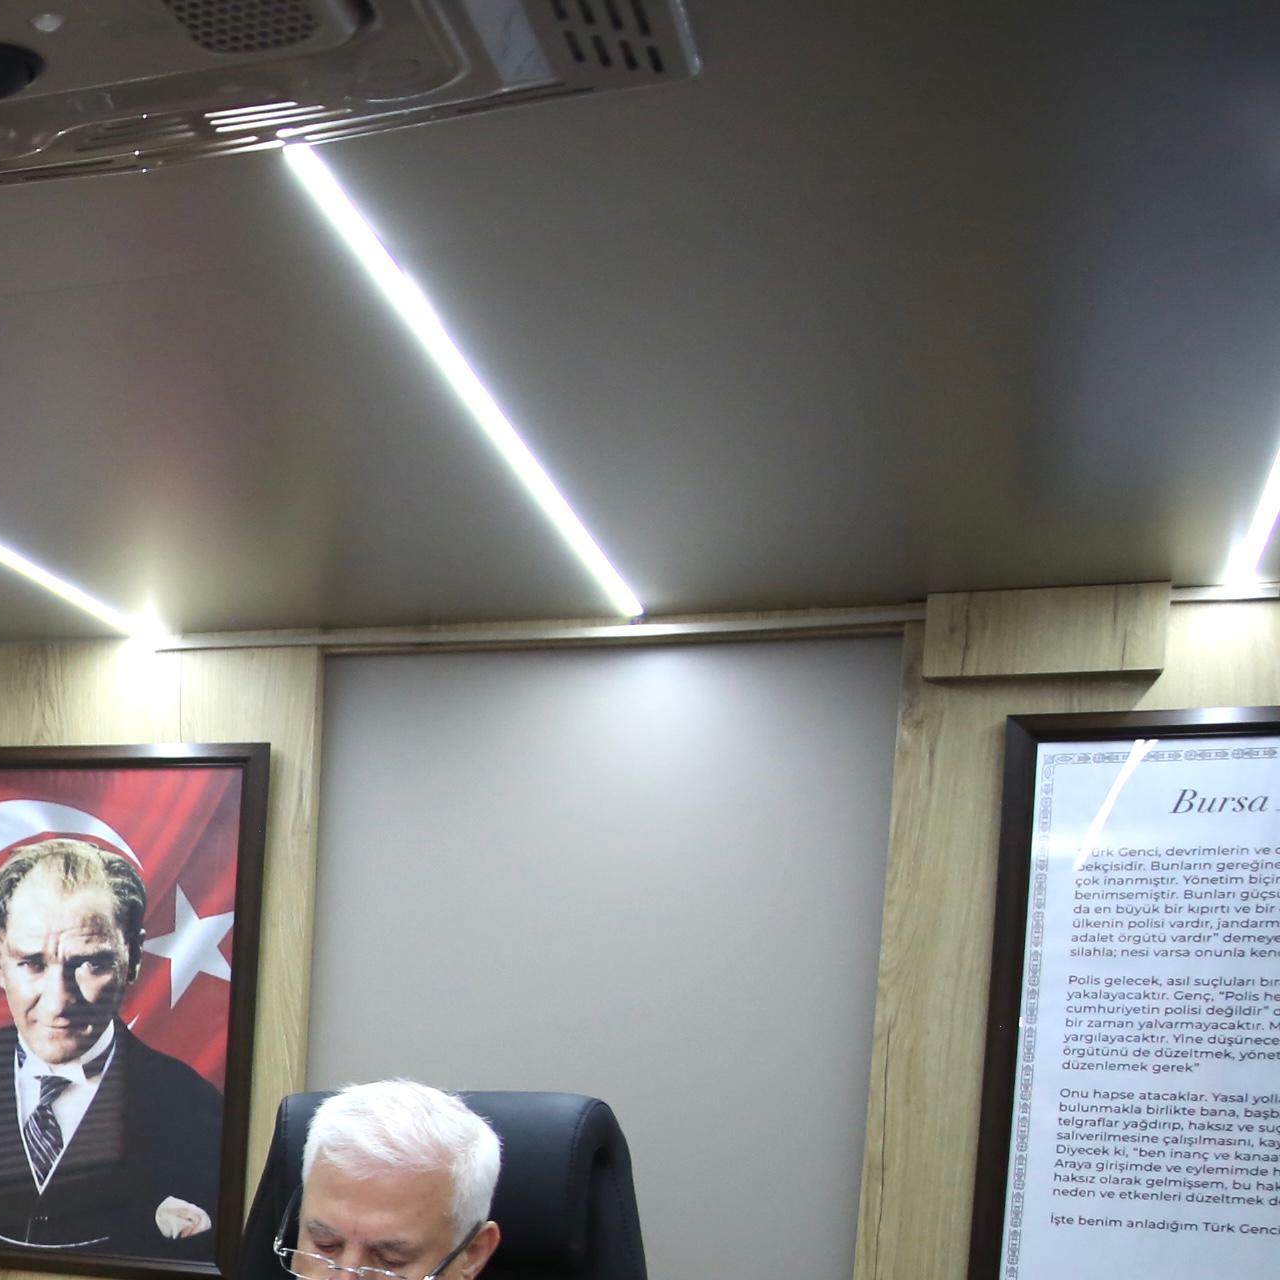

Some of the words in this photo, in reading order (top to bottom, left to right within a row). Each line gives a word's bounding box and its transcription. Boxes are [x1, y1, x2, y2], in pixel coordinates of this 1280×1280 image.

[1168, 789, 1269, 813] Bursa
[1078, 847, 1113, 856] ürk
[1118, 847, 1161, 858] Genci,
[1166, 846, 1249, 856] devrimlerin
[1151, 861, 1211, 871] Bunların
[1075, 875, 1100, 888] çok
[1104, 875, 1178, 887] inanmıştır.
[1183, 875, 1244, 885] Yönetim
[1075, 890, 1179, 901] benimsemiştir.
[1184, 889, 1235, 899] Bunları
[1073, 904, 1090, 914] da
[1094, 906, 1111, 914] en
[1116, 904, 1160, 916] büyük
[1165, 904, 1183, 914] bir
[1188, 904, 1229, 915] kıpırtı
[1256, 903, 1275, 913] bir
[1073, 918, 1123, 928] ülkenin
[1128, 918, 1164, 930] polisi
[1169, 918, 1213, 930] vardır,
[1072, 932, 1114, 943] adalet
[1118, 934, 1166, 945] örgütü
[1121, 947, 1149, 957] nesi
[1153, 949, 1190, 957] varsa
[1195, 947, 1245, 957] onunla
[1069, 976, 1100, 985] Polis
[1105, 976, 1162, 987] gelecek,
[1167, 977, 1189, 986] asıl
[1194, 977, 1255, 988] suçluları
[1067, 990, 1169, 1002] yakalayacaktır.
[1174, 991, 1214, 1002] Genç,
[1066, 1004, 1160, 1016] cumhuriyetin
[1164, 1005, 1201, 1016] polisi
[1066, 1018, 1083, 1028] bir
[1088, 1020, 1133, 1029] zaman
[1138, 1019, 1264, 1031] yalvarmayacaktır.
[1063, 1033, 1167, 1044] yargılayacaktır.
[1172, 1034, 1203, 1044] Yine
[1063, 1047, 1128, 1058] örgütünü
[1133, 1048, 1150, 1057] de
[1155, 1048, 1235, 1060] düzeltmek,
[1062, 1061, 1148, 1072] düzenlemek
[1060, 1088, 1089, 1099] Onu
[1093, 1089, 1135, 1101] hapse
[1139, 1090, 1207, 1102] atacaklar.
[1212, 1092, 1248, 1103] Yasal
[1059, 1103, 1141, 1114] bulunmakla
[1147, 1105, 1196, 1116] birlikte
[1200, 1107, 1239, 1118] bana,
[1058, 1117, 1118, 1128] telgraflar
[1122, 1119, 1183, 1131] yağdırıp,
[1189, 1121, 1233, 1132] haksız
[1237, 1124, 1254, 1133] ve
[1057, 1131, 1158, 1144] salıverilmesine
[1163, 1134, 1254, 1148] çalışılmasını,
[1056, 1144, 1109, 1157] Diyecek
[1114, 1146, 1128, 1158] ki,
[1171, 1149, 1208, 1162] inanç
[1214, 1152, 1229, 1160] ve
[1054, 1159, 1091, 1170] Araya
[1096, 1161, 1162, 1173] girişimde
[1166, 1164, 1181, 1173] ve
[1186, 1164, 1268, 1177] eylemimde
[1054, 1173, 1095, 1184] haksız
[1100, 1174, 1141, 1185] olarak
[1146, 1177, 1228, 1191] gelmişsem,
[1233, 1180, 1251, 1191] bu
[1053, 1187, 1095, 1198] neden
[1100, 1191, 1115, 1199] ve
[1119, 1190, 1181, 1202] etkenleri
[1186, 1192, 1264, 1206] düzeltmek
[1050, 1213, 1074, 1226] İşte
[1079, 1215, 1122, 1228] benim
[1126, 1218, 1198, 1232] anladığım
[1203, 1221, 1234, 1233] Türk
